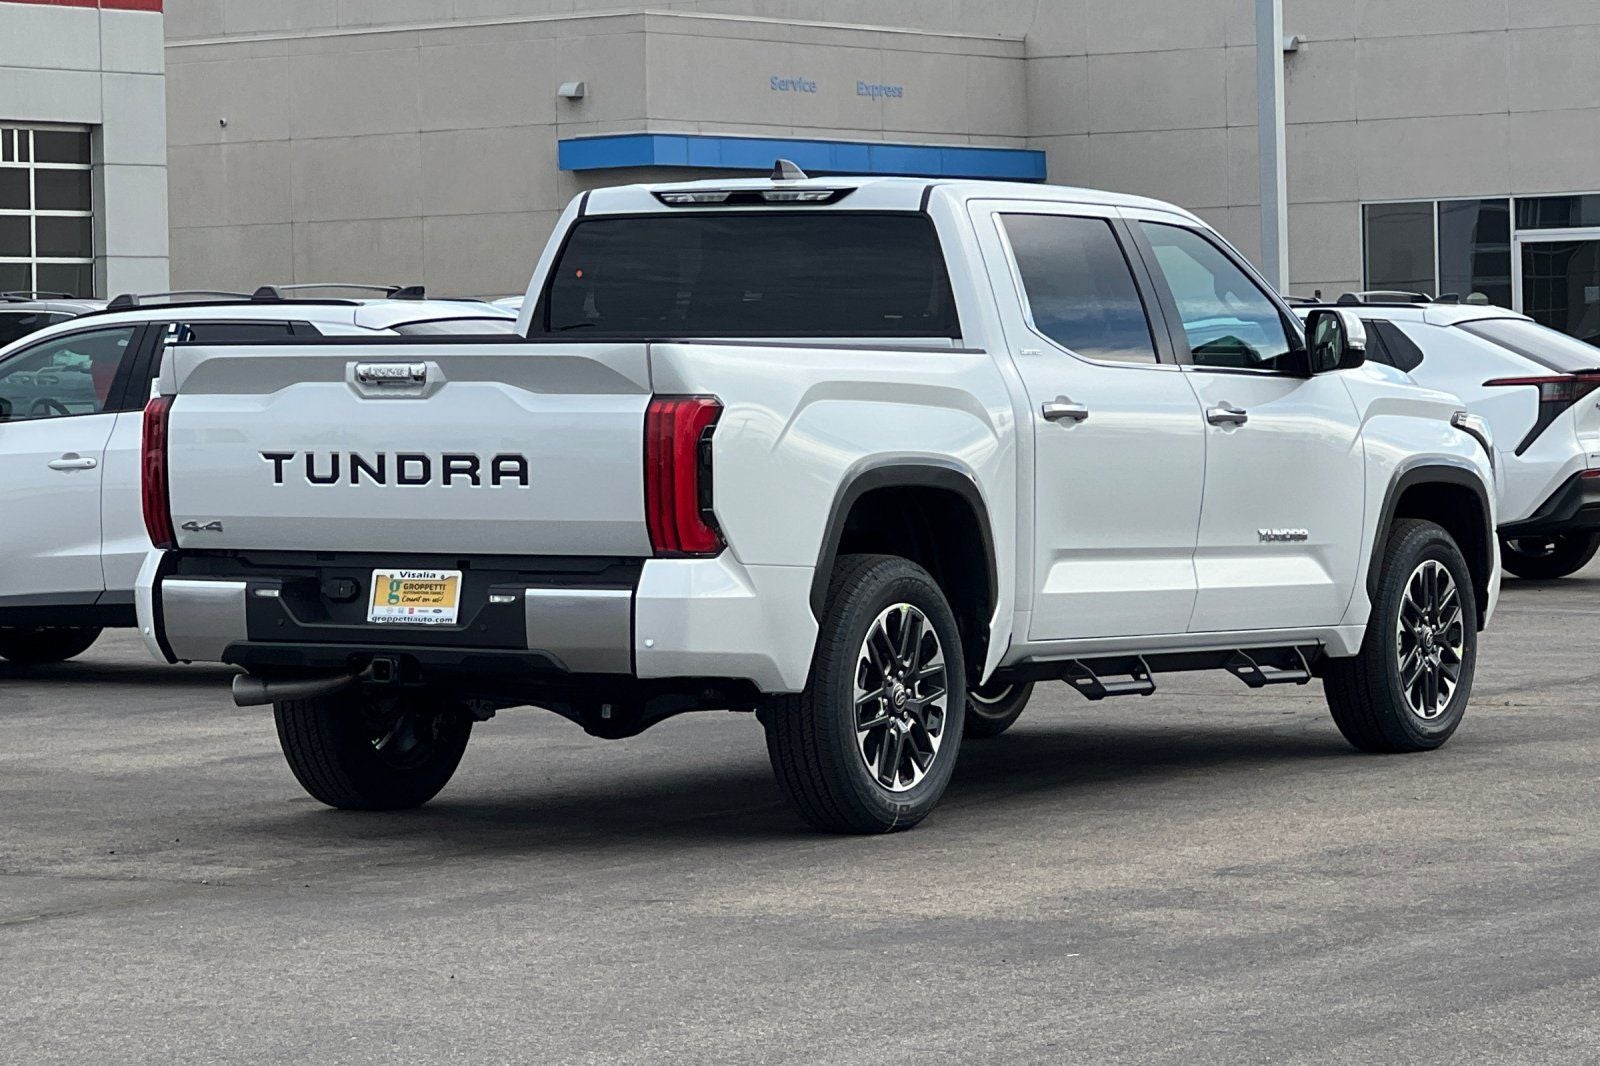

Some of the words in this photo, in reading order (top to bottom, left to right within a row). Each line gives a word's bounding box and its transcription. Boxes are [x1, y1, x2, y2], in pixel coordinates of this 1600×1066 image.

[769, 76, 817, 93] Service
[856, 80, 903, 101] Express
[257, 451, 531, 488] TUNDRA
[400, 571, 437, 579] Visalia
[403, 583, 447, 591] GROPPETTI
[371, 615, 453, 623] groppettiauto.com
